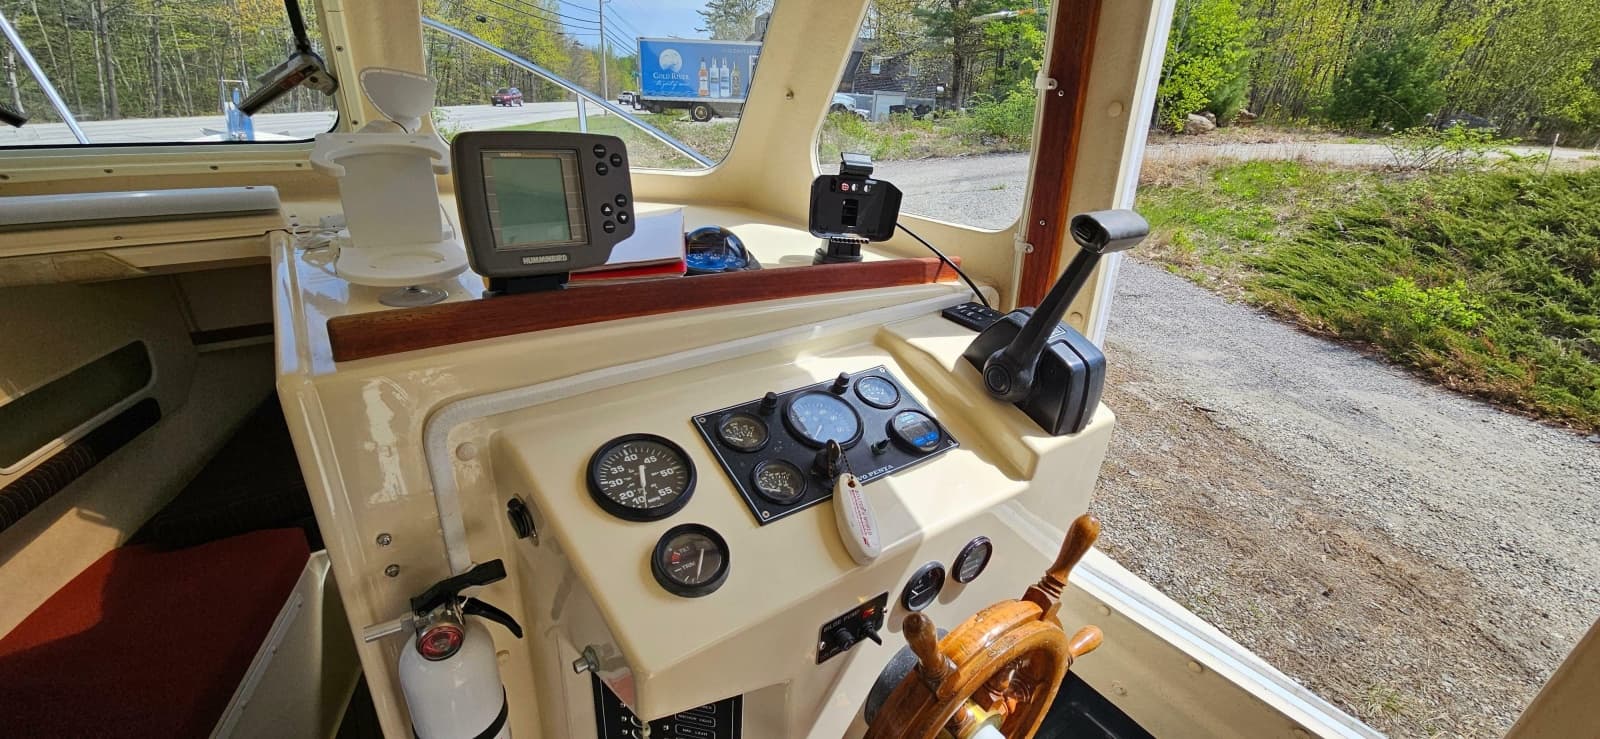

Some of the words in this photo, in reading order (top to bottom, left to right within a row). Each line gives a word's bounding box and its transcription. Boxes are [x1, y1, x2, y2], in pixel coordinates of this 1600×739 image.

[522, 254, 568, 265] HUMMINBIRD
[624, 453, 638, 462] 40
[643, 455, 657, 464] 45
[610, 465, 625, 475] 35
[660, 467, 674, 478] 50
[867, 464, 894, 477] PENTA
[608, 478, 624, 488] 30
[619, 490, 635, 501] 20
[658, 486, 673, 497] 55
[632, 495, 646, 505] 10
